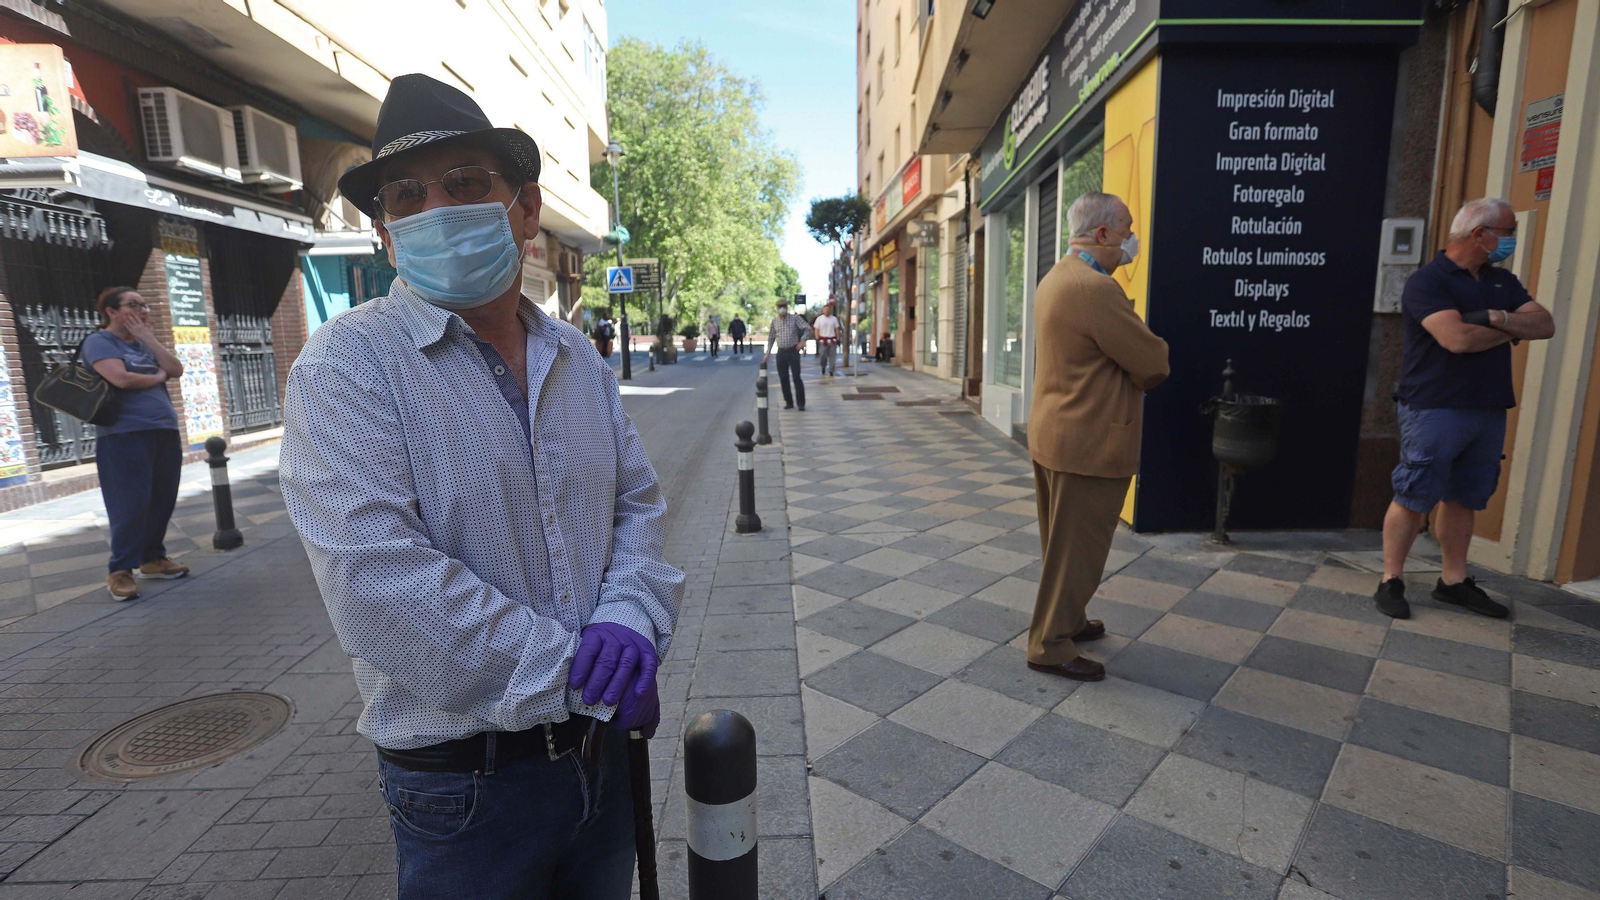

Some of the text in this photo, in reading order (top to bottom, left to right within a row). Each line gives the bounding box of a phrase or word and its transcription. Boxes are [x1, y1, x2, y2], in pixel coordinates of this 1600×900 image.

[1217, 88, 1334, 113] Impresión Digital
[1229, 121, 1318, 141] Gran formato
[1216, 152, 1326, 176] Imprenta Digital
[1233, 184, 1305, 207] Fotoregalo
[1231, 215, 1302, 235] Rotulación
[1202, 246, 1326, 266] Rotulos Luminosos
[1234, 278, 1290, 302] Displays
[1209, 309, 1311, 332] Textil y Regalos
